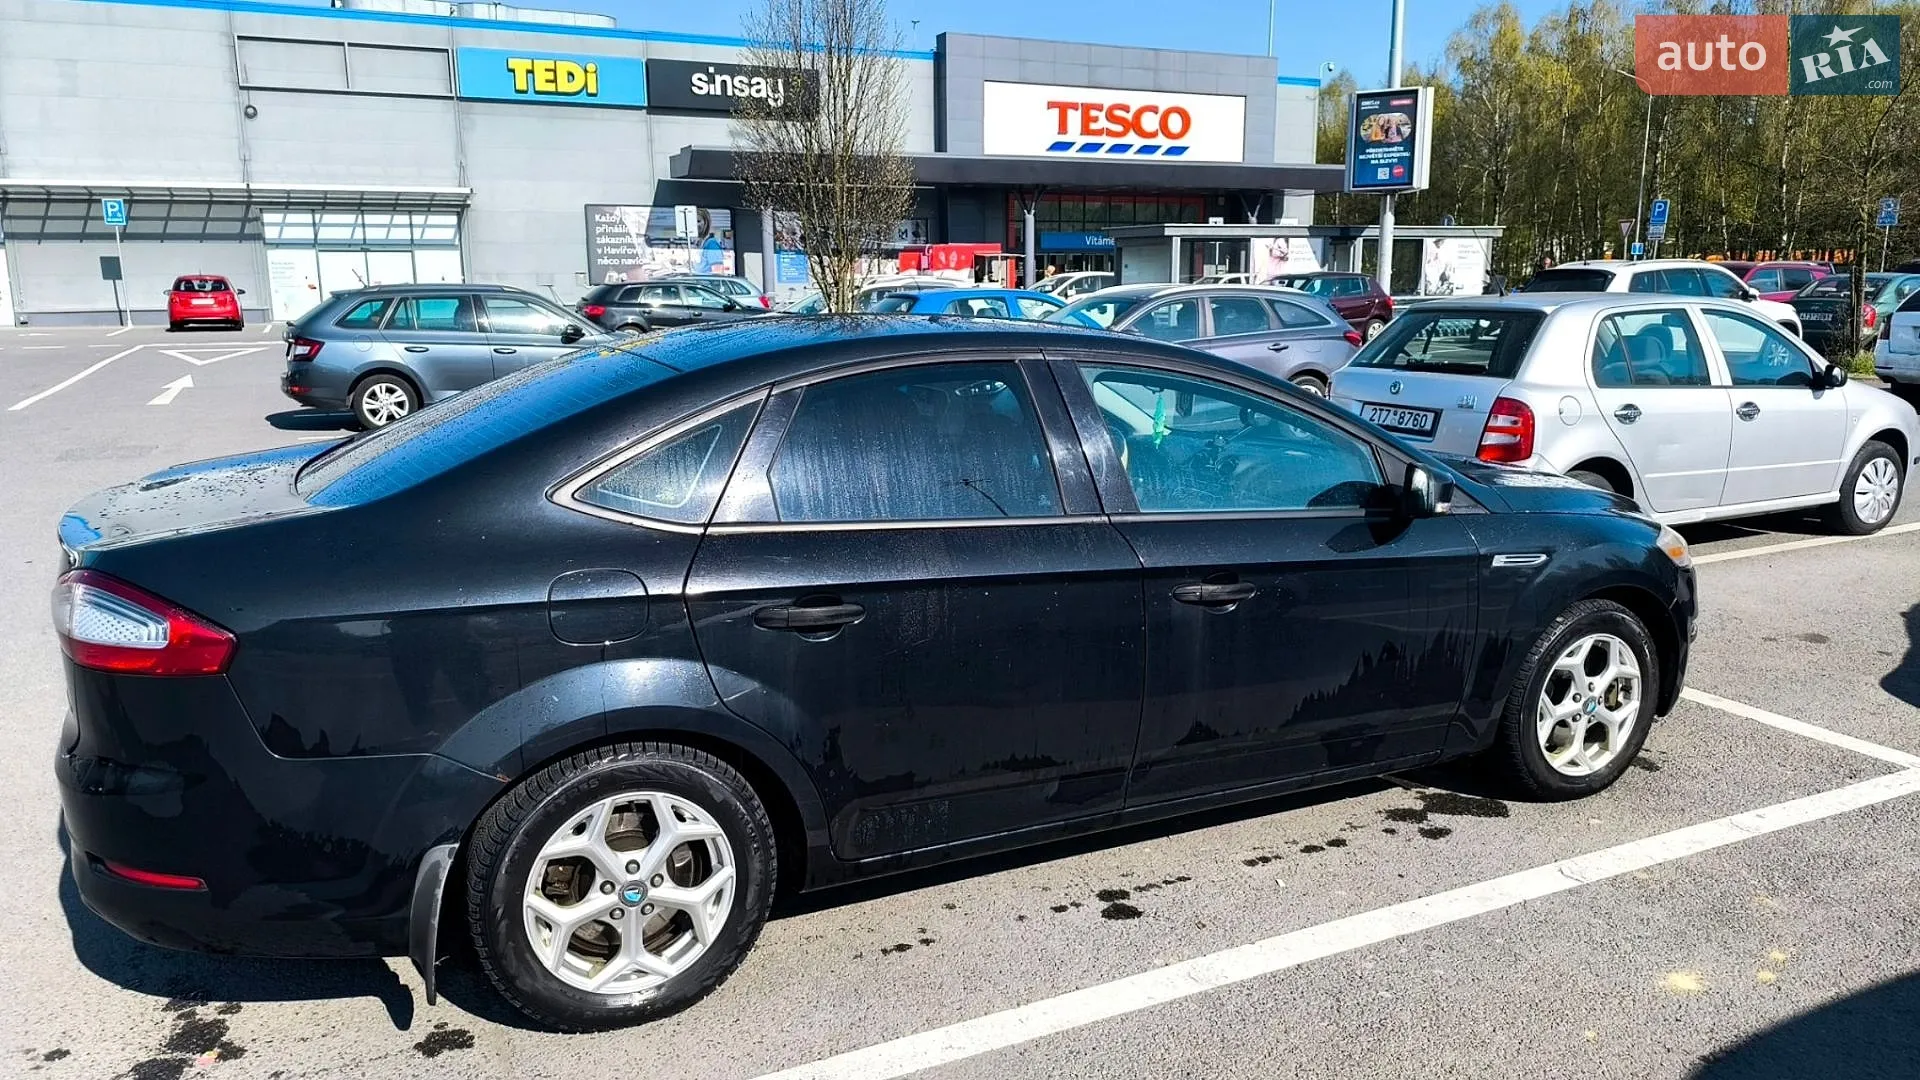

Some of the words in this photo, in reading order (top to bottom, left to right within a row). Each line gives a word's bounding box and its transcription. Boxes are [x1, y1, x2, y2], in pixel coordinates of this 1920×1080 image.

[506, 57, 599, 97] TEDi
[690, 66, 784, 107] sinsay
[1046, 101, 1192, 140] TESCO
[1654, 202, 1665, 217] P
[1369, 407, 1391, 424] 2T7
[1397, 410, 1428, 429] 8760
